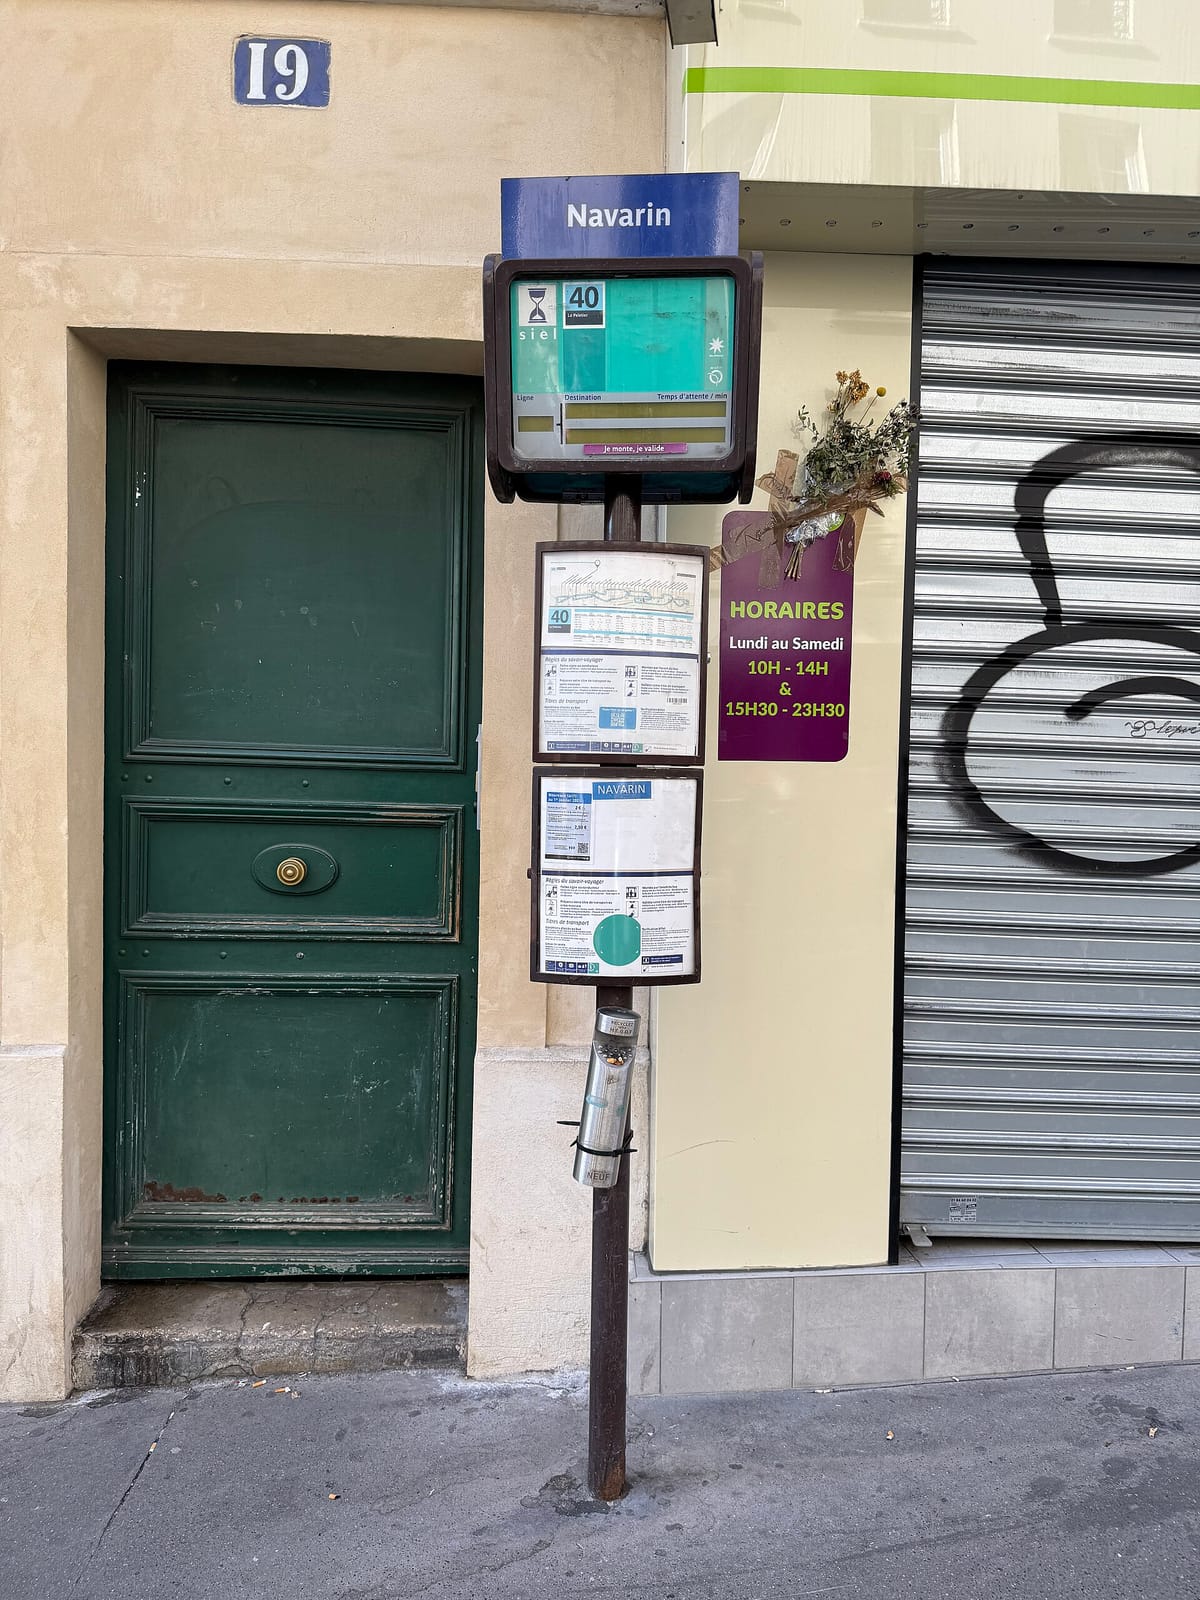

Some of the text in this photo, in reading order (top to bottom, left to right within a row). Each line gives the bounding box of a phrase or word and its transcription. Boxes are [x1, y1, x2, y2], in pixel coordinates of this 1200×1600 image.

[247, 42, 309, 101] 19
[567, 202, 671, 228] Navarin
[569, 286, 599, 308] 40
[519, 328, 557, 340] siel
[517, 394, 534, 402] Ligne
[564, 393, 602, 401] Destination
[657, 393, 679, 401] Temps
[679, 392, 709, 400] d'attente
[715, 392, 728, 400] min
[603, 444, 665, 453] Je monte, je valide
[551, 610, 569, 623] 40
[730, 600, 844, 620] HORAIRES
[729, 636, 844, 650] Lundi au Samedi
[748, 660, 780, 675] 10H
[796, 661, 828, 676] 14H
[779, 682, 792, 696] &
[726, 701, 779, 716] 15H30
[792, 702, 845, 717] 23H30
[597, 784, 646, 794] NAVARIN
